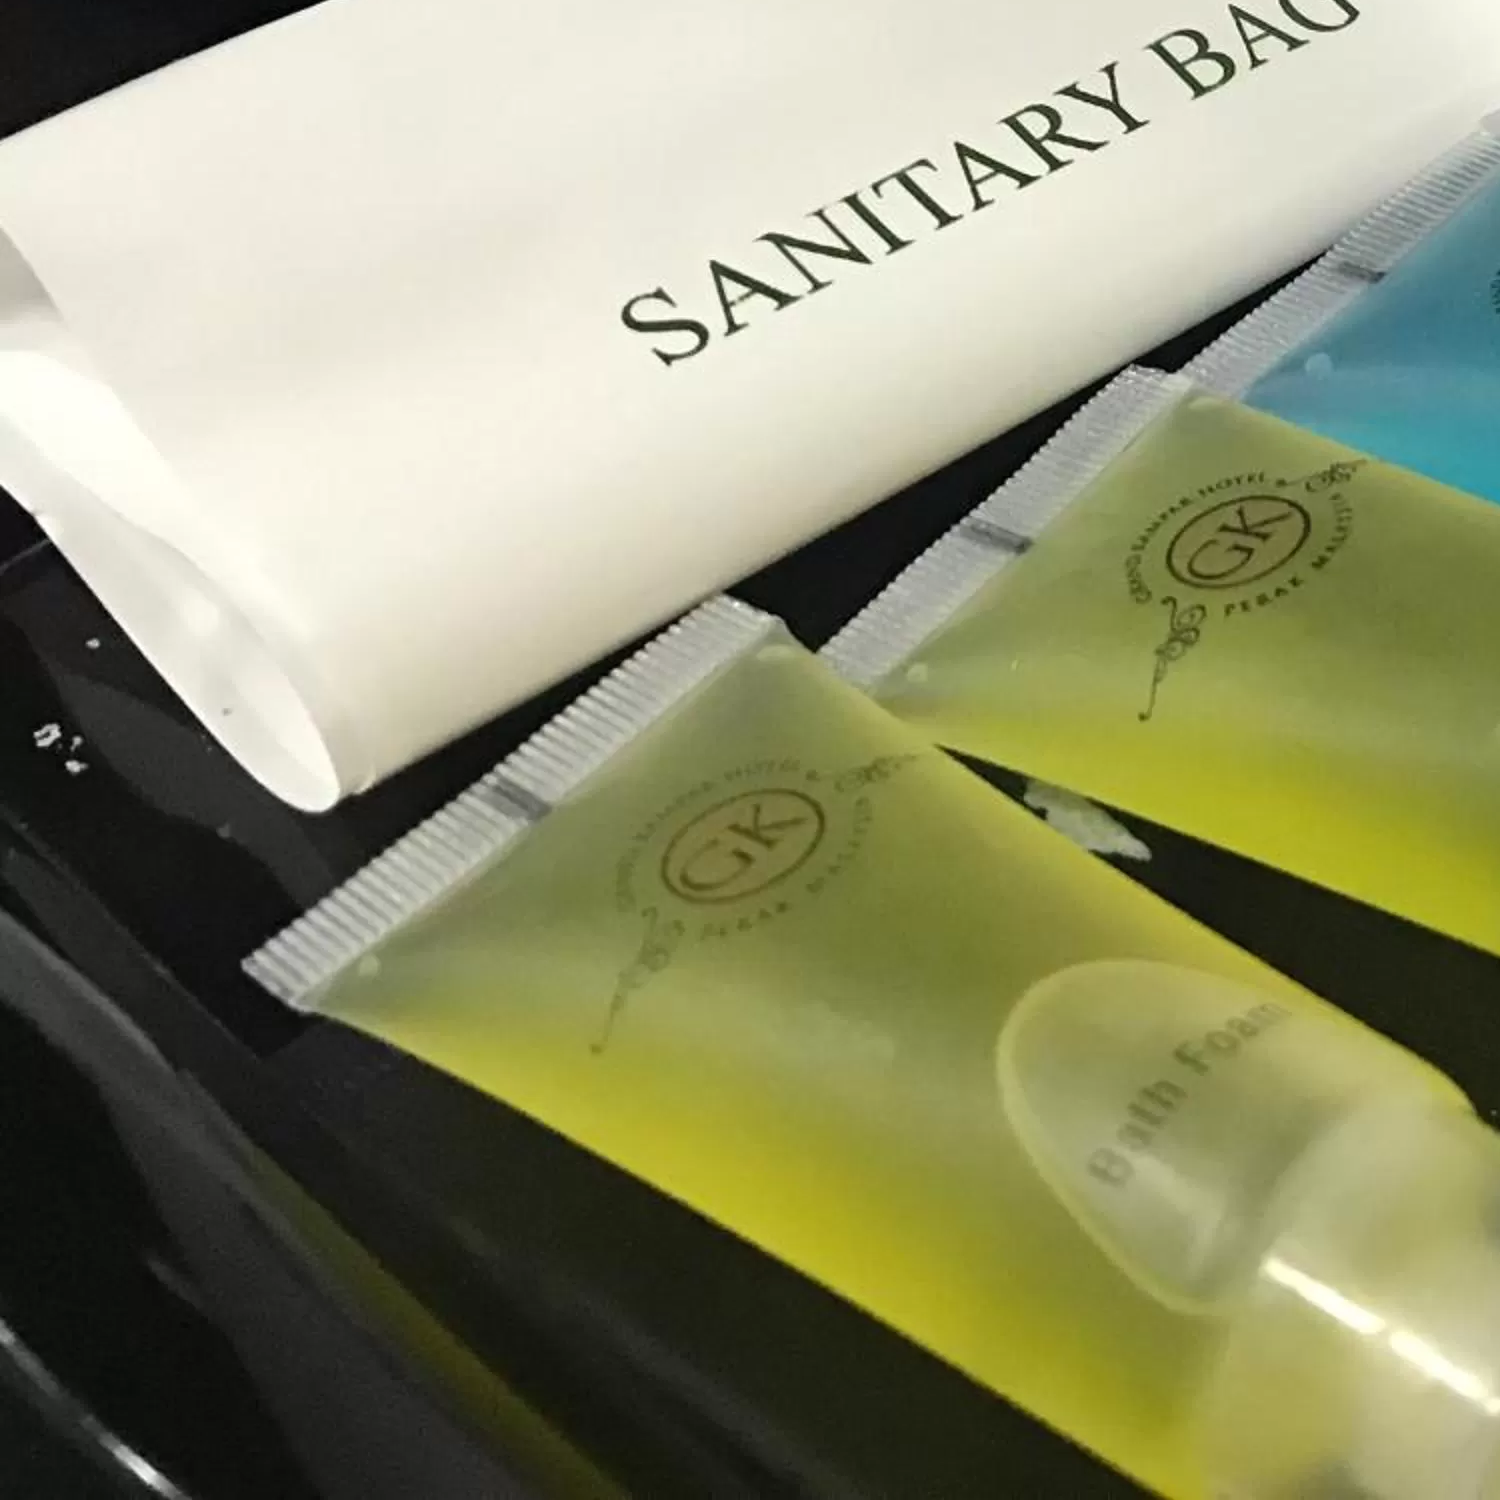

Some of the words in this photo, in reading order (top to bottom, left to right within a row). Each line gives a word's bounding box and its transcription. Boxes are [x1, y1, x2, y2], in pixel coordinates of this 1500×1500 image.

[619, 60, 1151, 368] SANITARY
[1187, 503, 1296, 581] GK
[679, 801, 809, 892] GK
